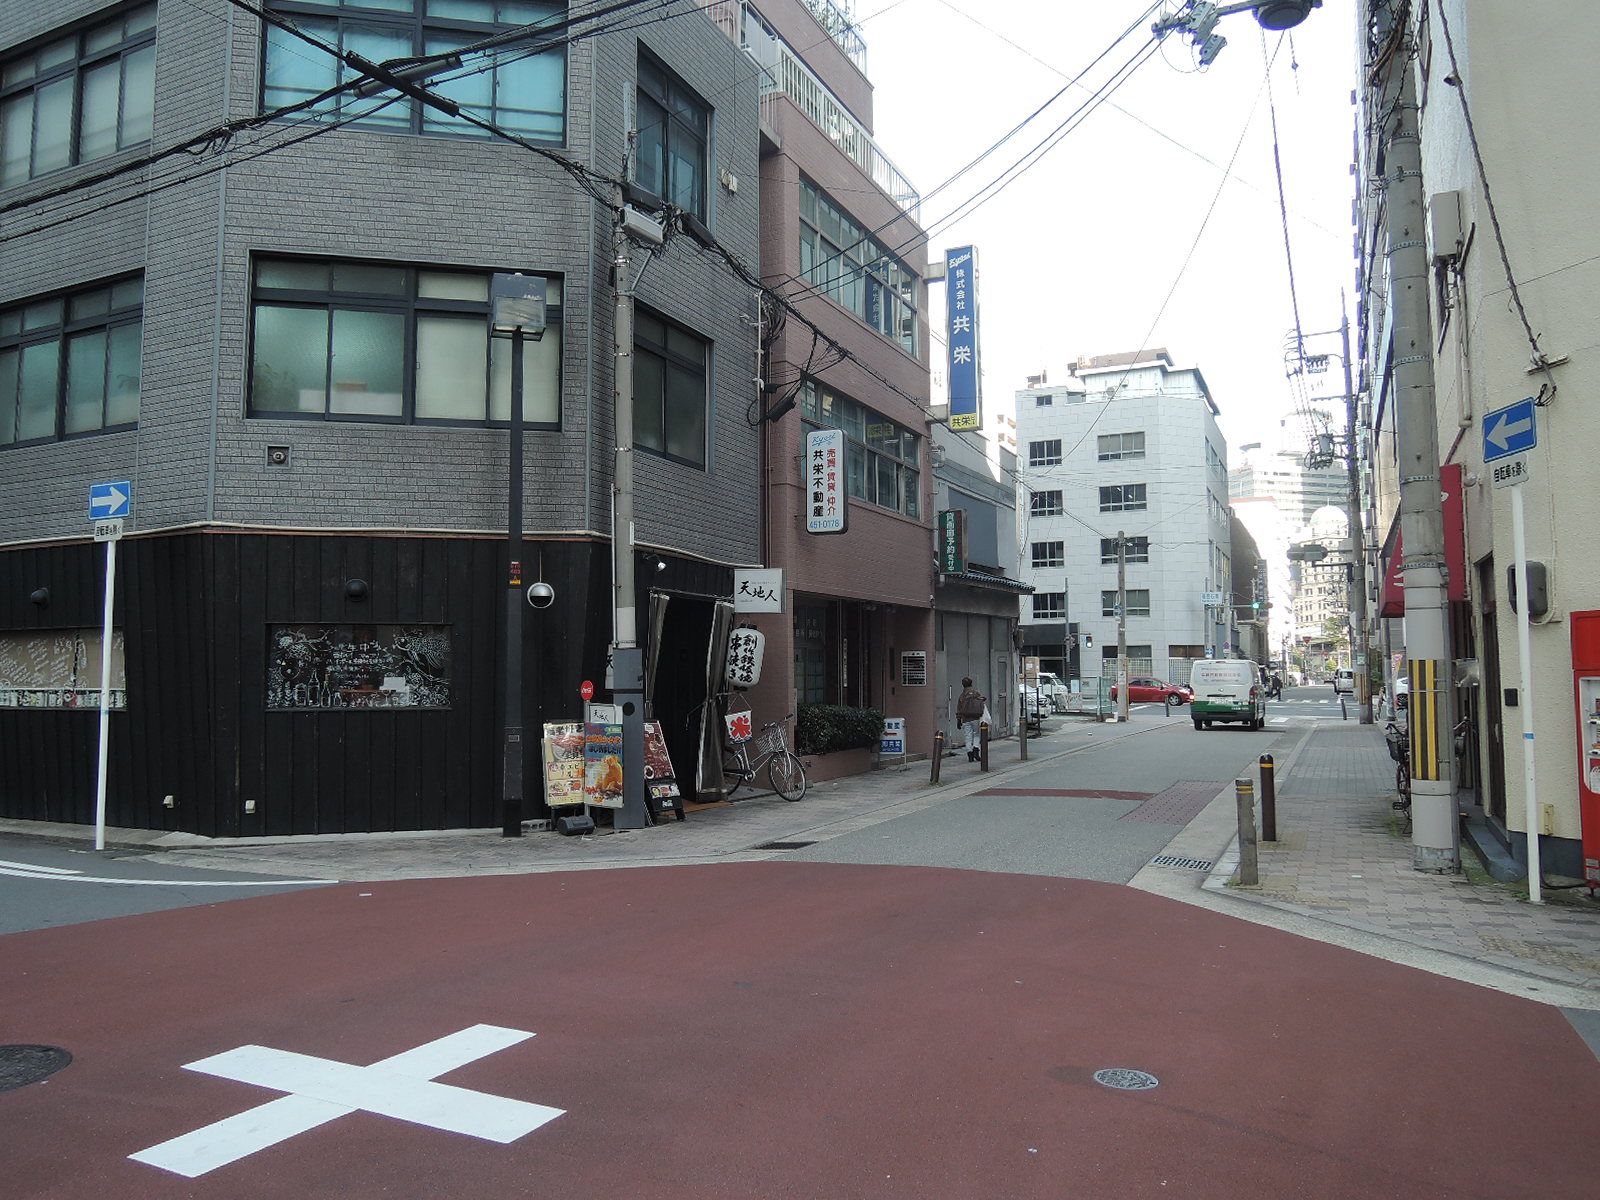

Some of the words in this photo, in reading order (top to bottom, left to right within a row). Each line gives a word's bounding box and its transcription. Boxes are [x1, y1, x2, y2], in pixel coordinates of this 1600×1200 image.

[956, 269, 966, 311] 株式会社
[953, 315, 971, 365] 共栄
[813, 449, 824, 517] 共栄不動産
[1494, 461, 1527, 482] 自転車を除く
[737, 580, 778, 602] 天地人
